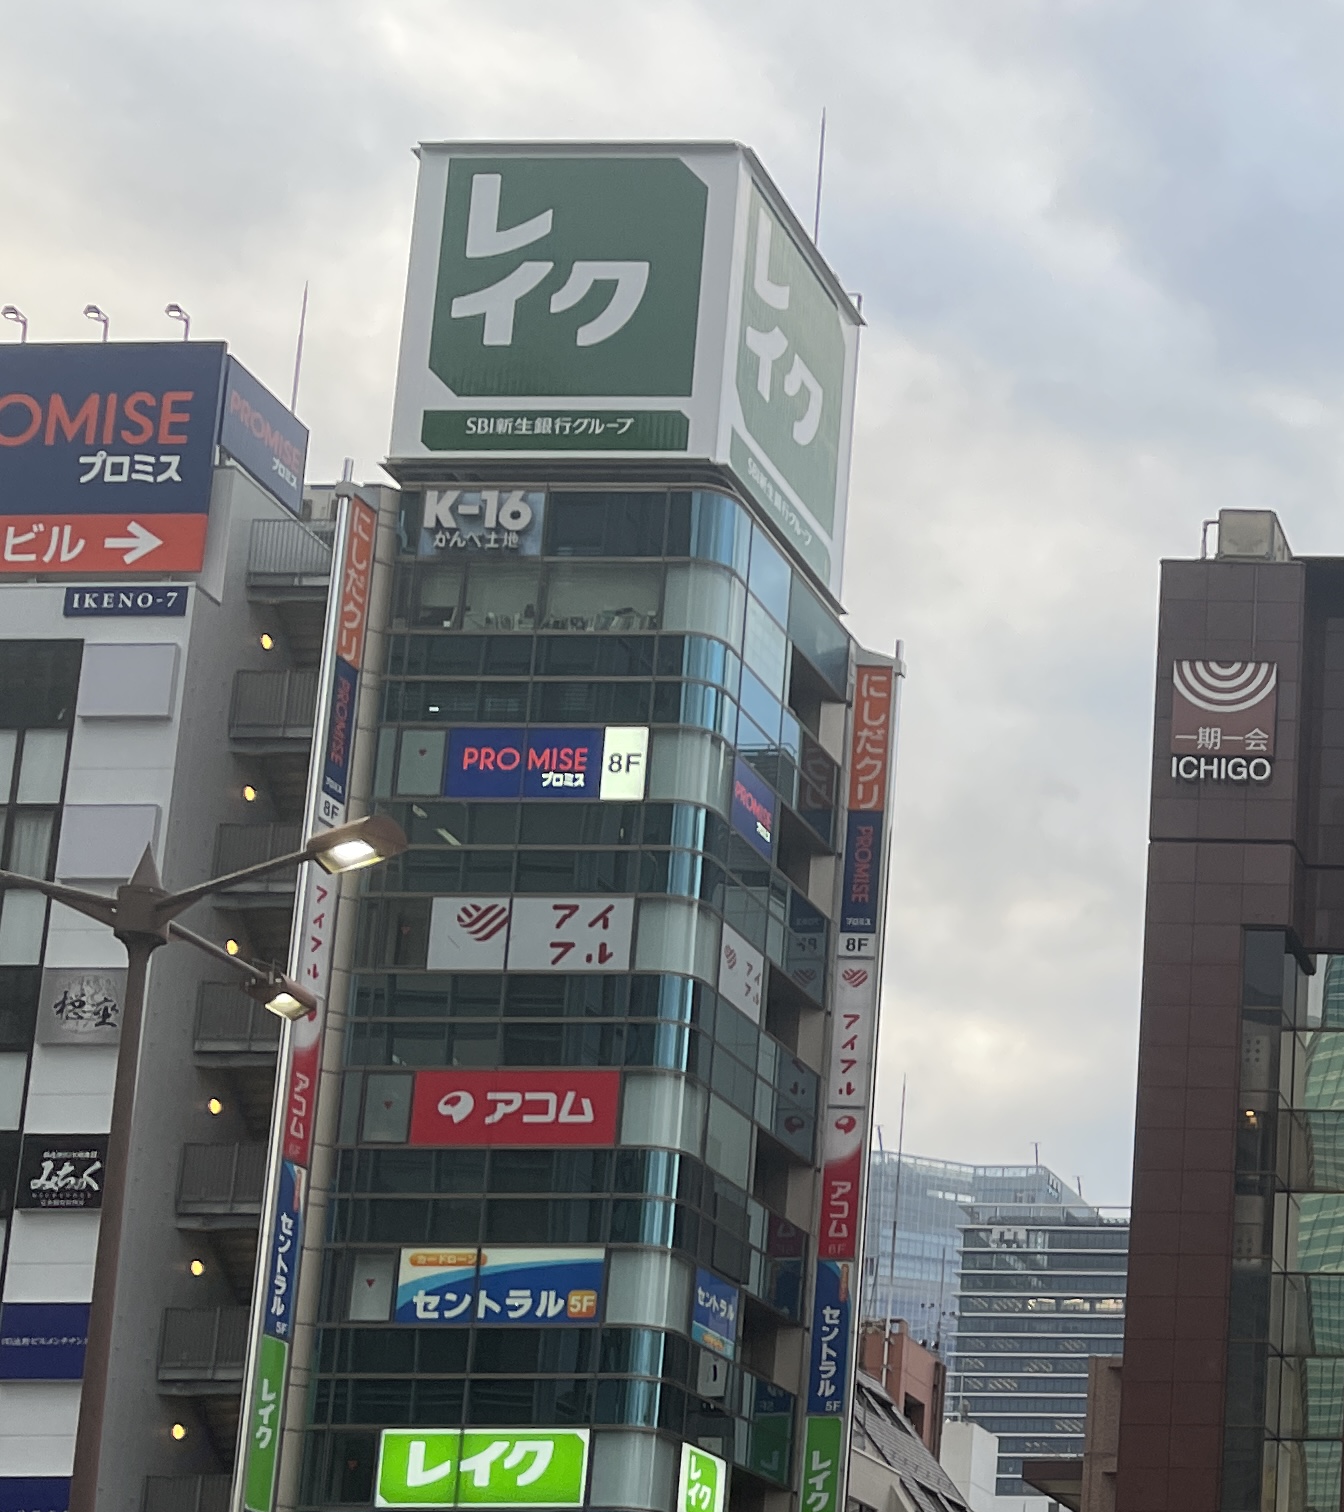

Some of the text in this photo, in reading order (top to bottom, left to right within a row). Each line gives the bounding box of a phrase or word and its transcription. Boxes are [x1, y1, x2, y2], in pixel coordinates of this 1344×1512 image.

[228, 388, 301, 476] PROMISE
[465, 417, 635, 435] SBI新生銀行グループ
[79, 450, 182, 484] プロミス
[271, 455, 298, 491] プロミス
[423, 490, 533, 531] K-16
[72, 590, 179, 608] IKENO-7
[856, 673, 888, 810] にしだクリ
[1175, 726, 1270, 751] 一期一会
[462, 746, 589, 771] PROMISE
[607, 752, 642, 773] 8F
[1171, 756, 1272, 781] ICHIGO
[541, 771, 585, 788] プロミス
[838, 1013, 860, 1097] アイフル
[485, 1090, 594, 1125] アコム
[828, 1180, 851, 1239] アコム
[271, 1211, 294, 1317] セントラル
[412, 1289, 595, 1319] セントラル 5F
[697, 1284, 735, 1322] セントラル
[817, 1304, 842, 1398] セントラル
[256, 1378, 276, 1450] レイク
[405, 1440, 555, 1488] レイク
[806, 1450, 832, 1512] レイク
